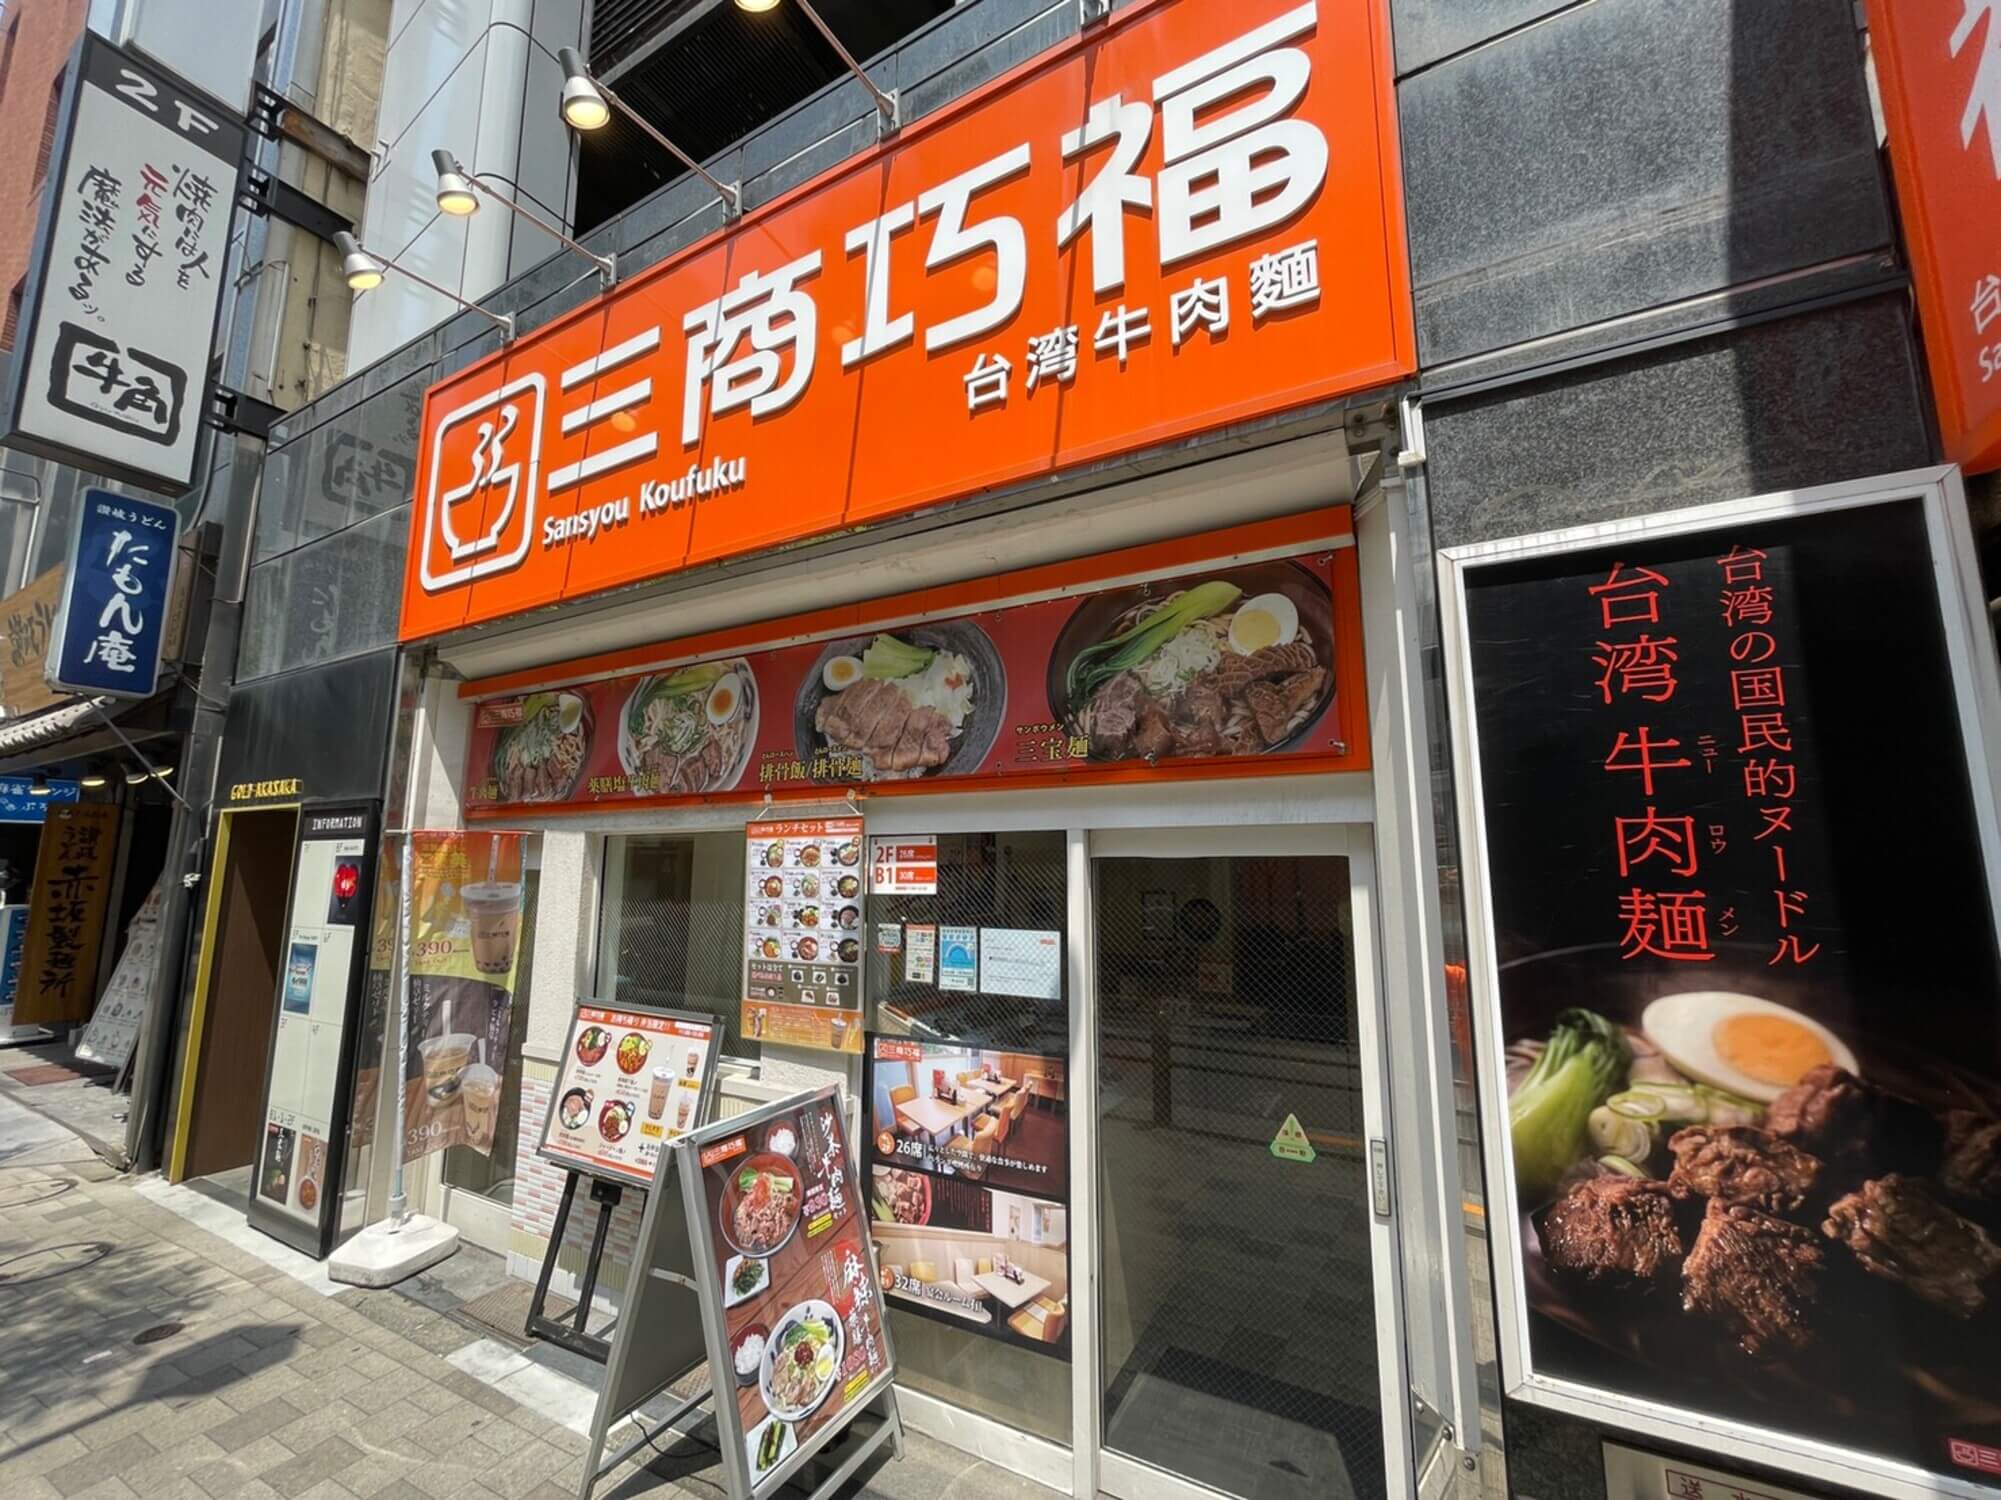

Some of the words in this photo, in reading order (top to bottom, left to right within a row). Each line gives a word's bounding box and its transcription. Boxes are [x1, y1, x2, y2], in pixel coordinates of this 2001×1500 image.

[115, 68, 220, 135] 2F
[125, 163, 170, 288] 元気にする
[547, 1, 1330, 491] 三商巧福
[72, 351, 169, 425] 牛角
[542, 493, 630, 547] Sansyou
[639, 455, 747, 512] Koufuku
[83, 529, 151, 673] たもん庵
[1587, 561, 1716, 962] 台湾牛肉麺
[1697, 734, 1719, 774] ニュー
[1716, 543, 1820, 966] 台湾の国民的ヌードル
[312, 816, 363, 831] INFORMATION
[775, 822, 824, 834] ランチセット
[1708, 824, 1727, 855] ロウ
[875, 866, 894, 884] B1
[876, 845, 894, 864] 2F
[1718, 906, 1740, 937] メン
[407, 1120, 443, 1145] 390
